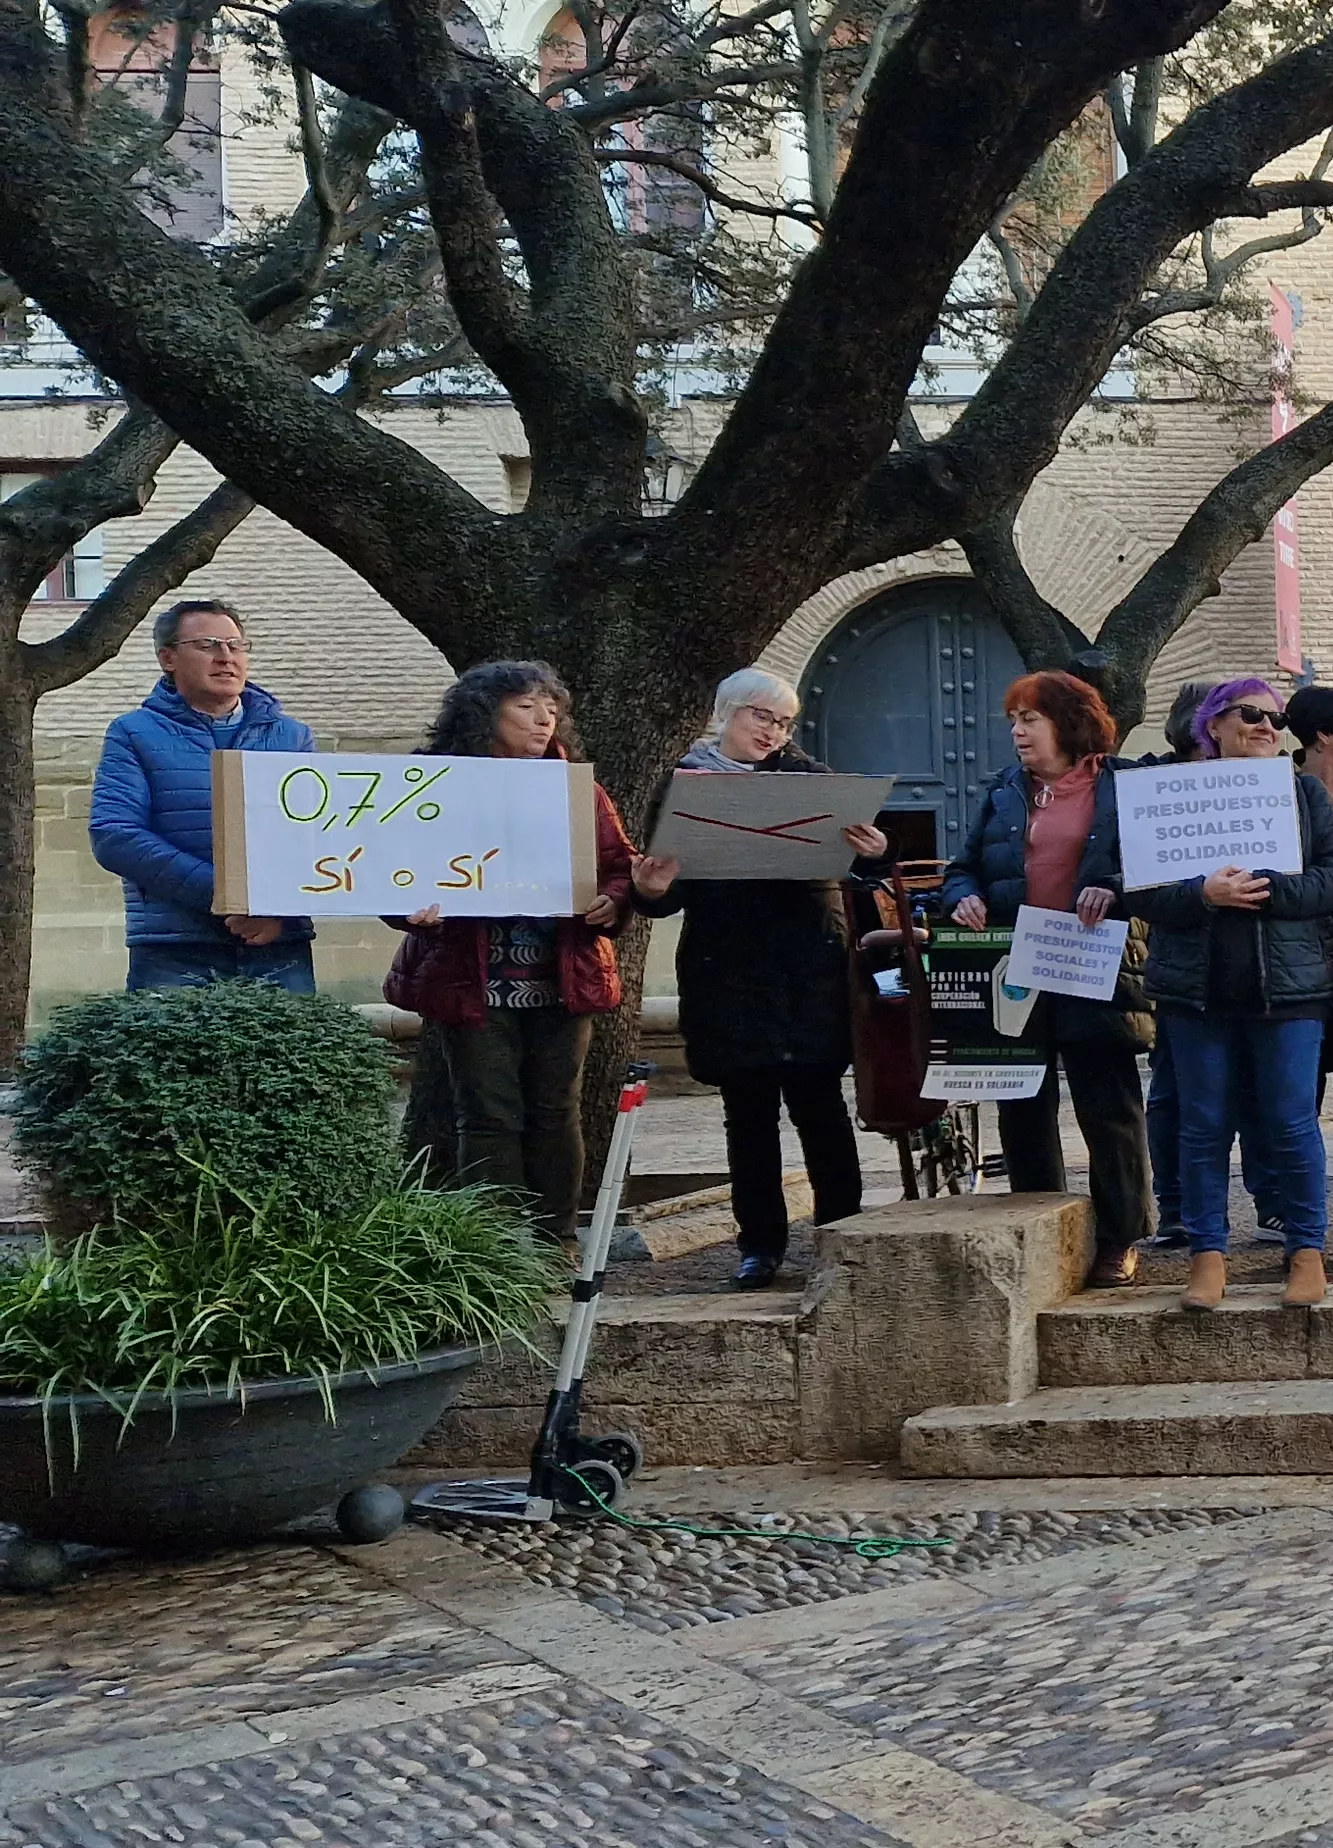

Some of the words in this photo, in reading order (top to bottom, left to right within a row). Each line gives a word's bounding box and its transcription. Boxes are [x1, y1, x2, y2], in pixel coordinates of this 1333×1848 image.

[1155, 778, 1198, 794] POR
[1202, 772, 1260, 790] UNOS
[280, 765, 451, 832] 0,7%
[1133, 793, 1293, 820] PRESUPUESTOS
[1155, 818, 1255, 841] SOCIALES
[1259, 817, 1274, 831] Y
[1156, 840, 1279, 863] SOLIDARIOS
[1044, 919, 1073, 932] POR
[1024, 932, 1122, 956] PRESUPUESTOS
[1035, 951, 1098, 968] SOCIALES
[1101, 961, 1109, 969] Y
[1032, 966, 1105, 986] SOLIDARIOS
